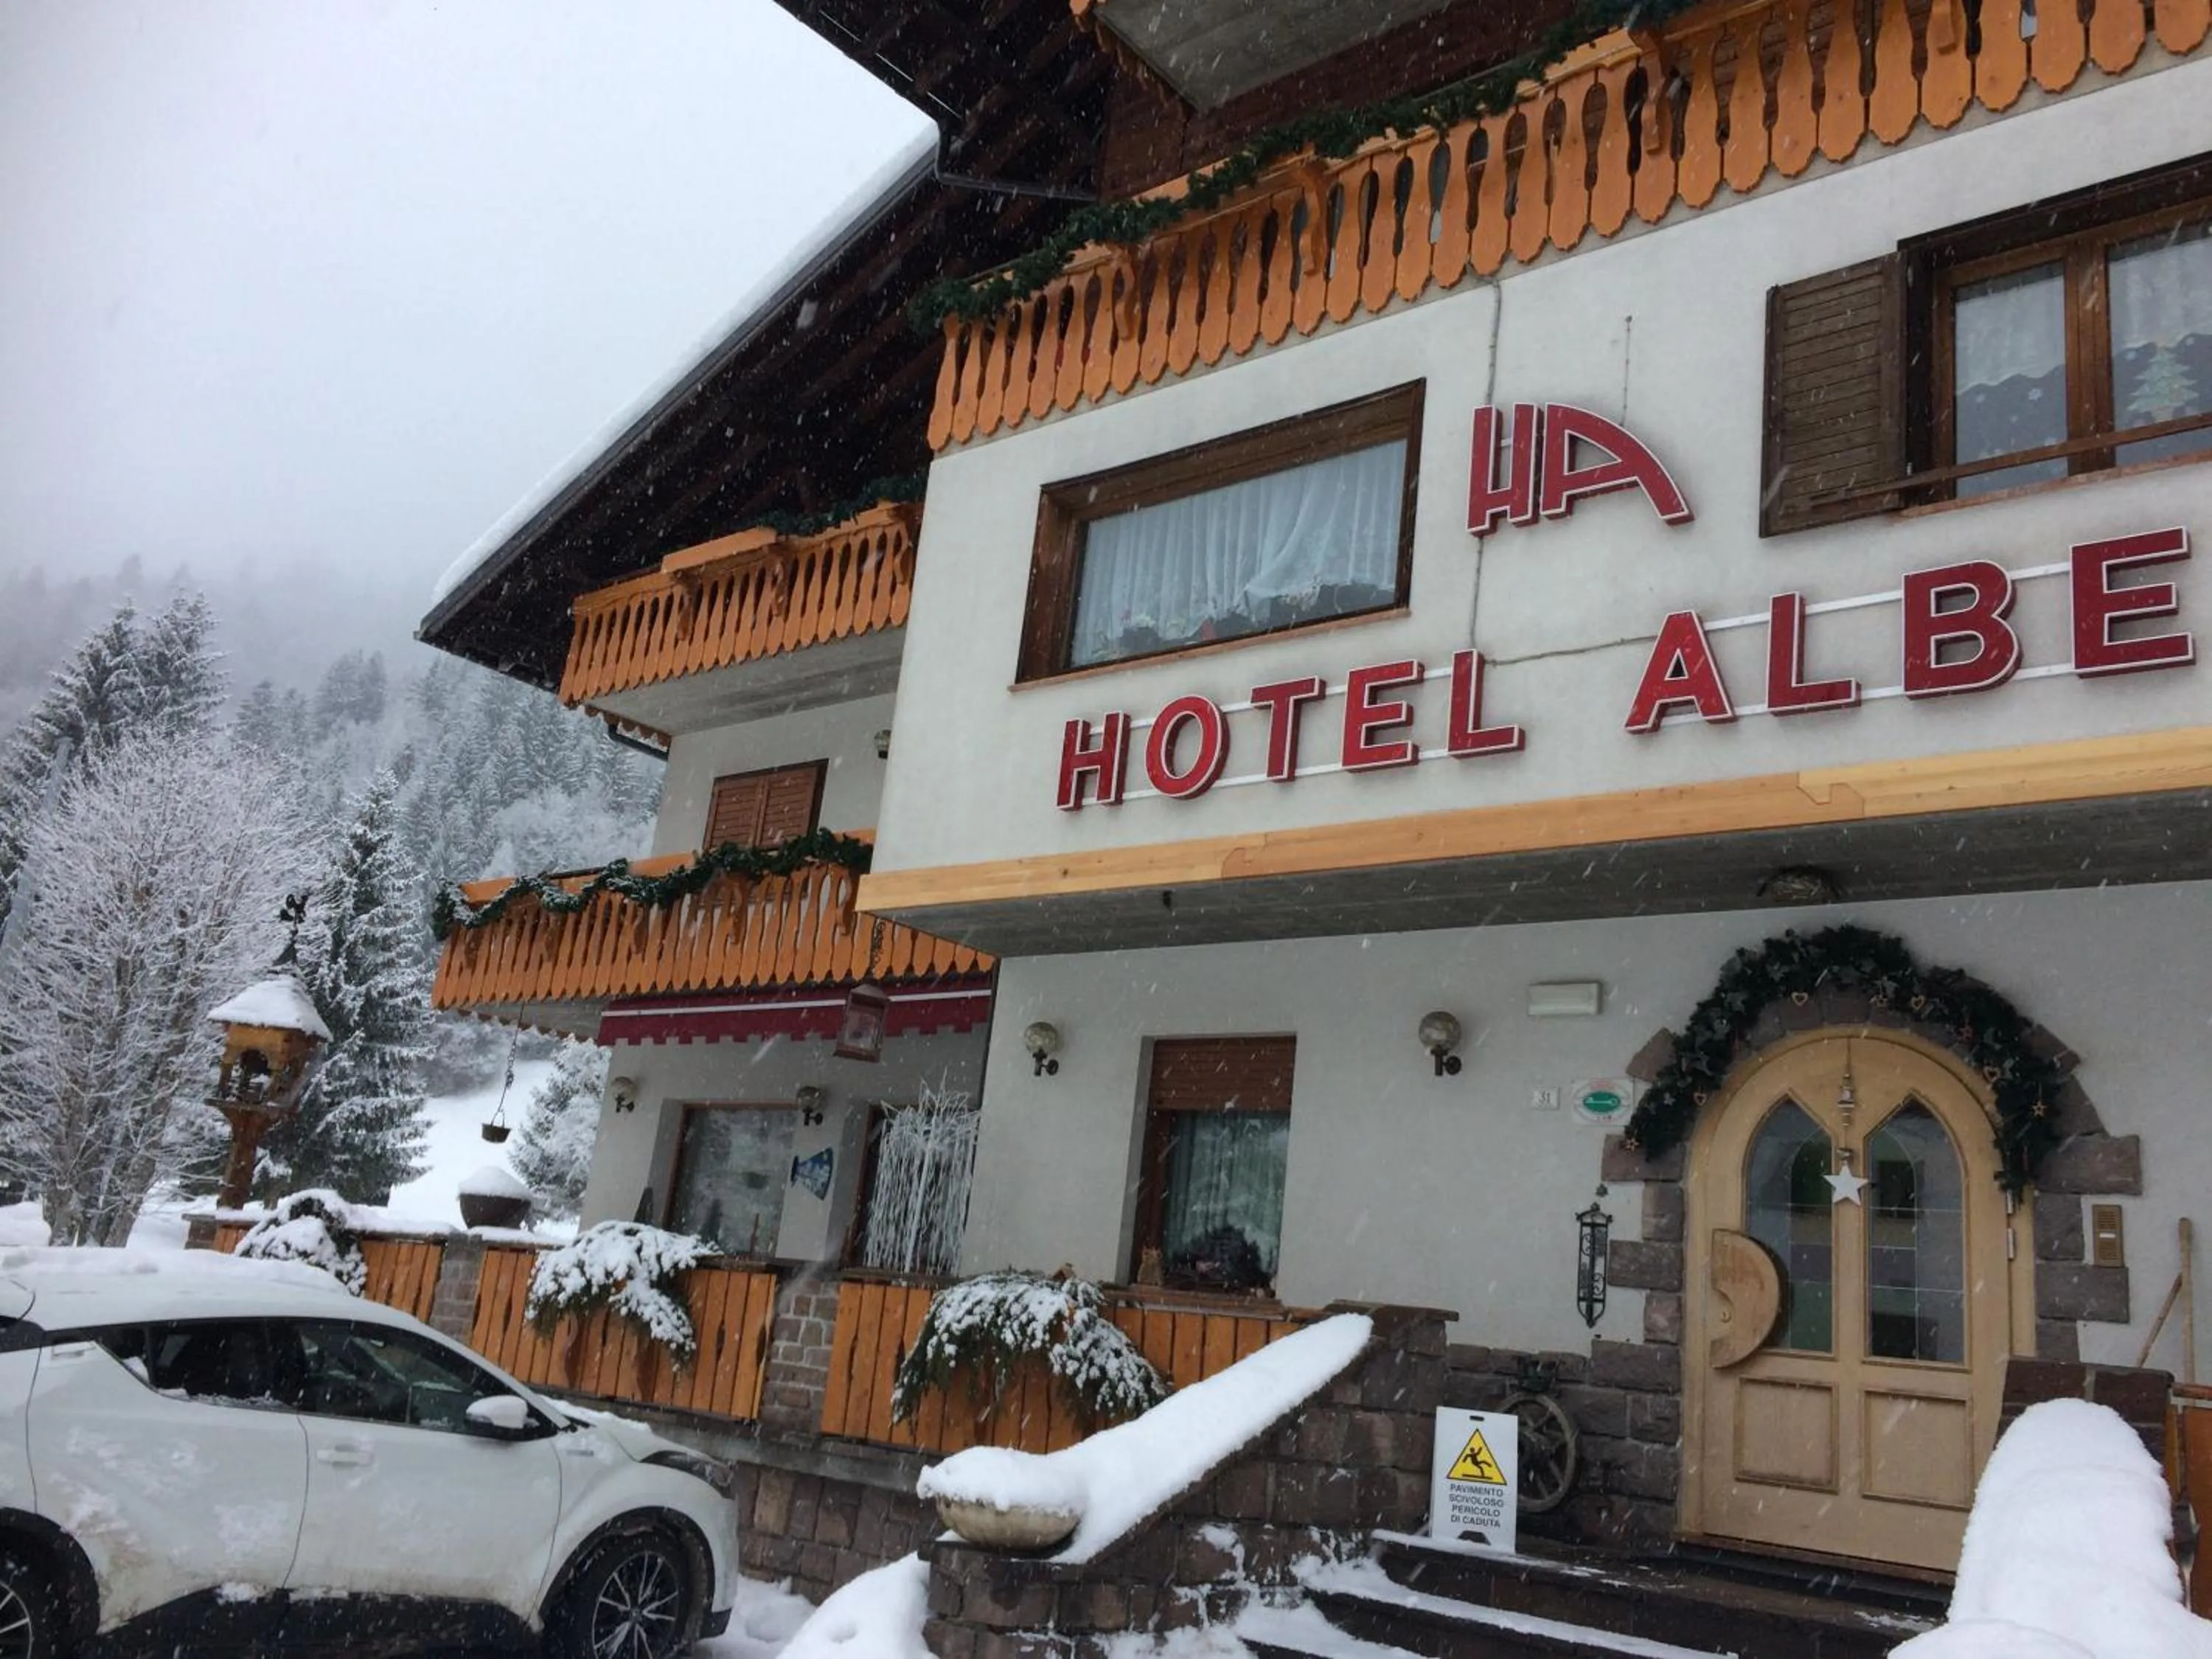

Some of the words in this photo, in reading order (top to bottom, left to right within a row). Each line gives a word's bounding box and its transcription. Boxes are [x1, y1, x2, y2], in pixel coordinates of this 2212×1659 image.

[1056, 649, 1526, 810] HOTEL
[1624, 526, 2196, 734] ALBE
[1450, 1483, 1503, 1497] PAVIMENTO
[1449, 1494, 1504, 1507] SCIVOLOSO
[1451, 1504, 1500, 1517] PERICOLO
[1450, 1514, 1460, 1523] DI
[1462, 1515, 1500, 1528] CADUTA
